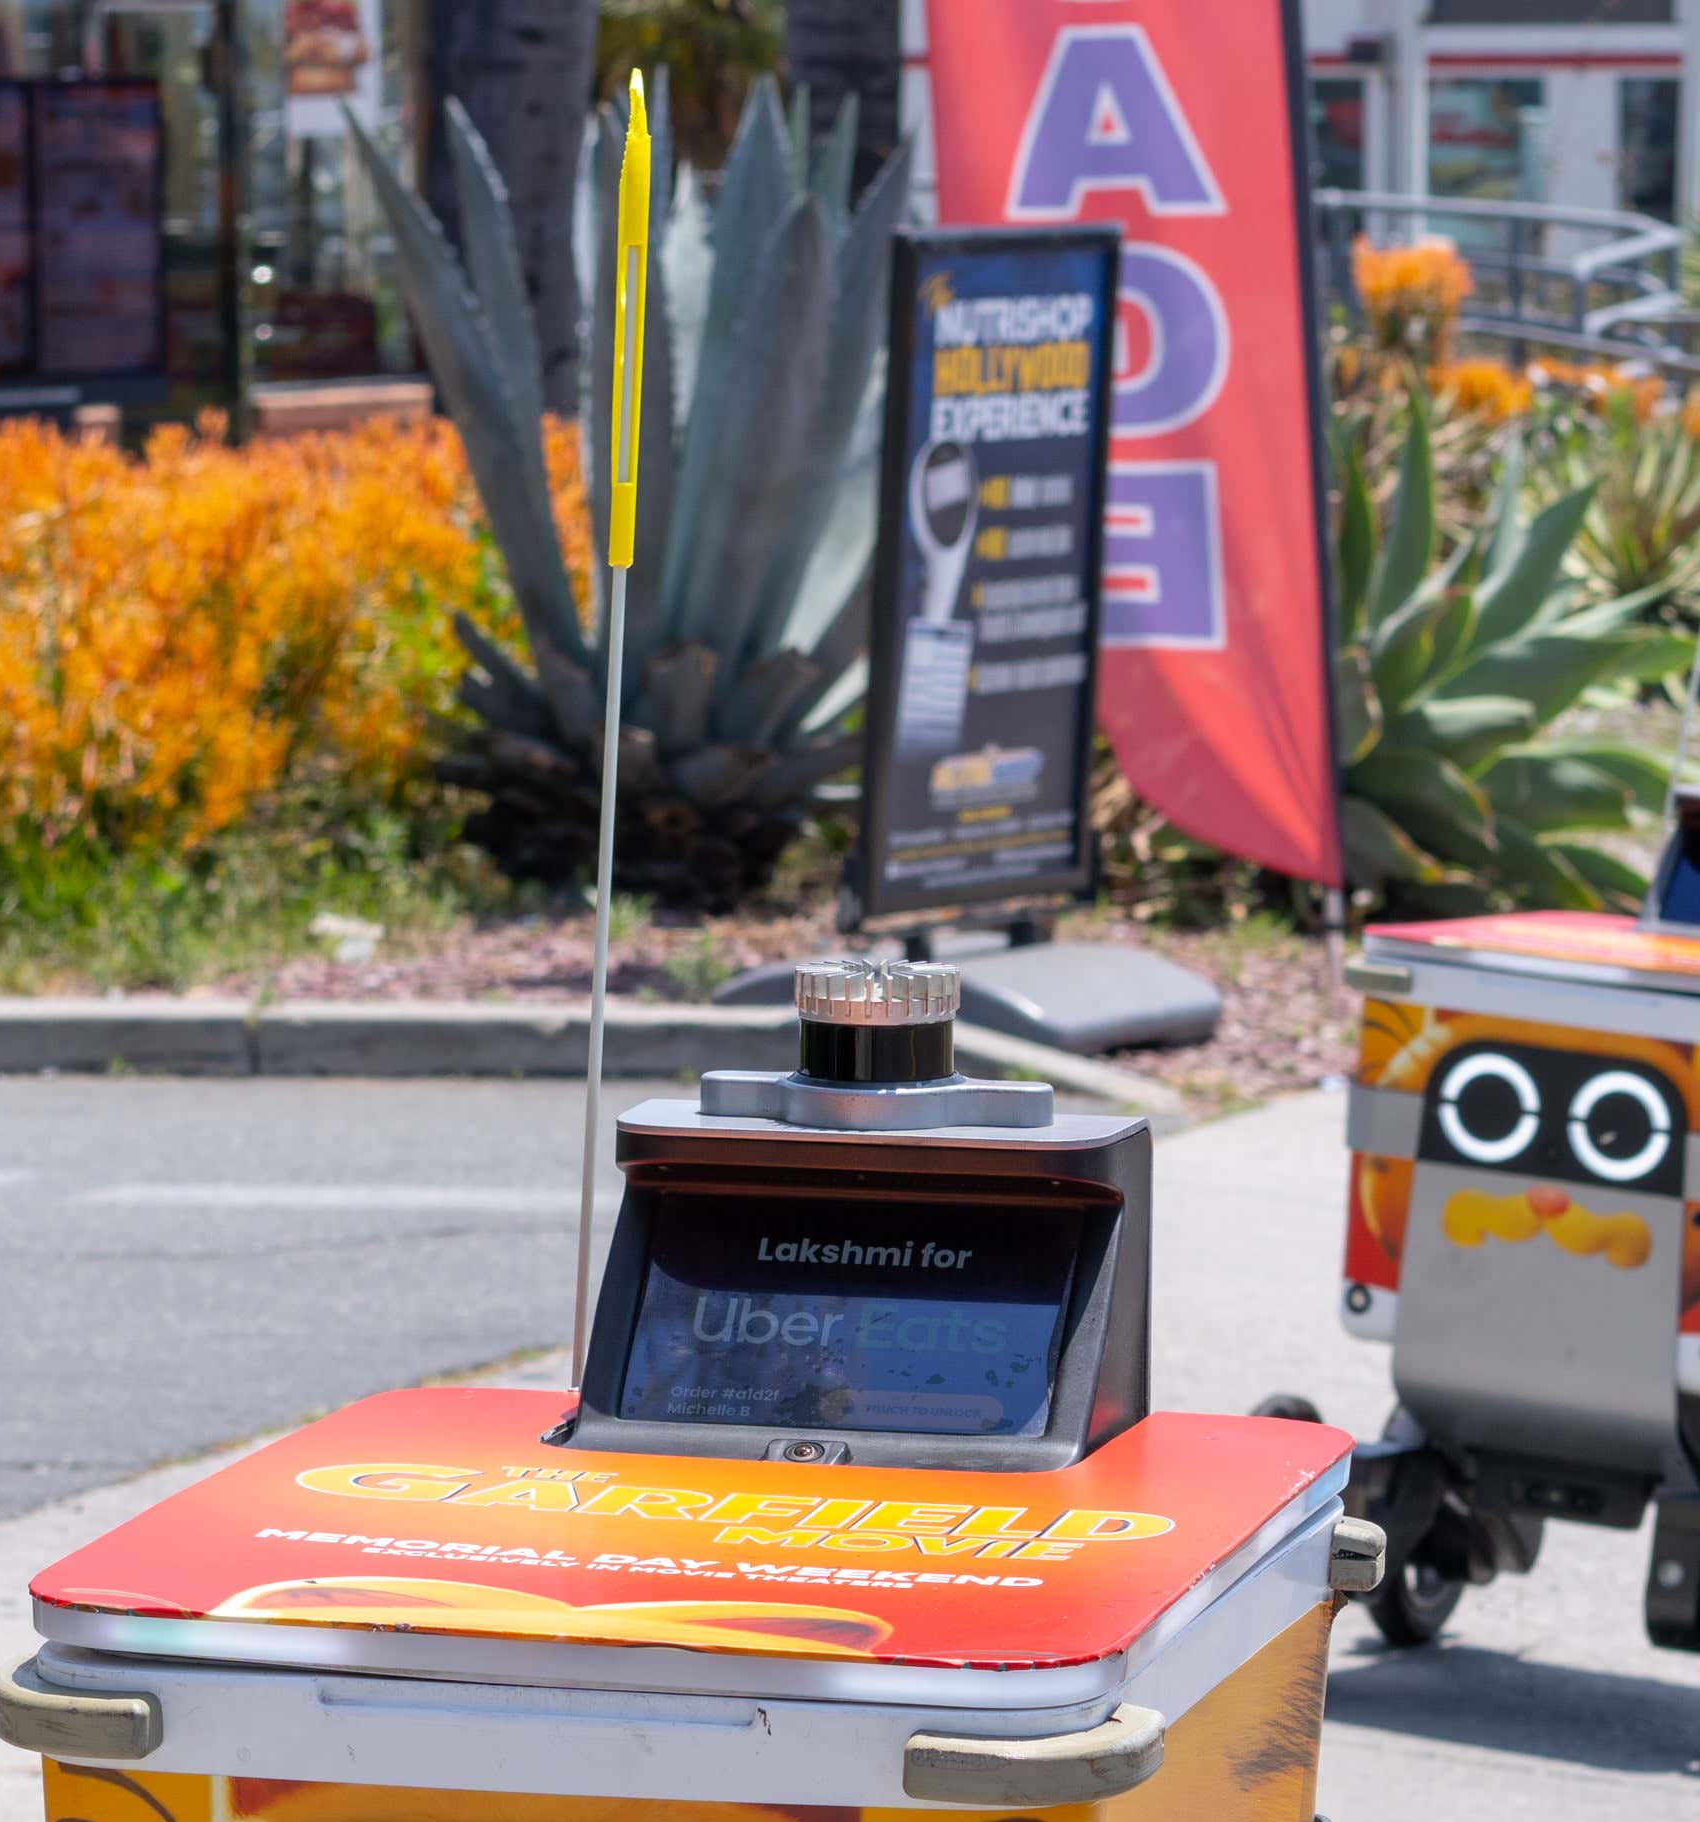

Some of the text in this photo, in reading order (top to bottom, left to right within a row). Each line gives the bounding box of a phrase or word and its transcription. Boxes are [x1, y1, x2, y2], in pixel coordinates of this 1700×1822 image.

[934, 294, 1092, 345] NUTRISHOP
[933, 341, 1089, 395] HOLLYWOOD
[929, 391, 1088, 442] EXPERIENCE
[757, 1237, 973, 1269] Lakshmi for
[692, 1296, 1006, 1352] Uber Eats
[670, 1385, 717, 1399] Order
[500, 1465, 620, 1483] THE
[294, 1463, 1176, 1542] GARFIELD
[253, 1528, 1044, 1588] MEMORIAL DAY WEEKEND
[361, 1547, 916, 1589] EXCLUSIVELY IN MOVIE THEATERS
[712, 1525, 1086, 1561] MOVIE
